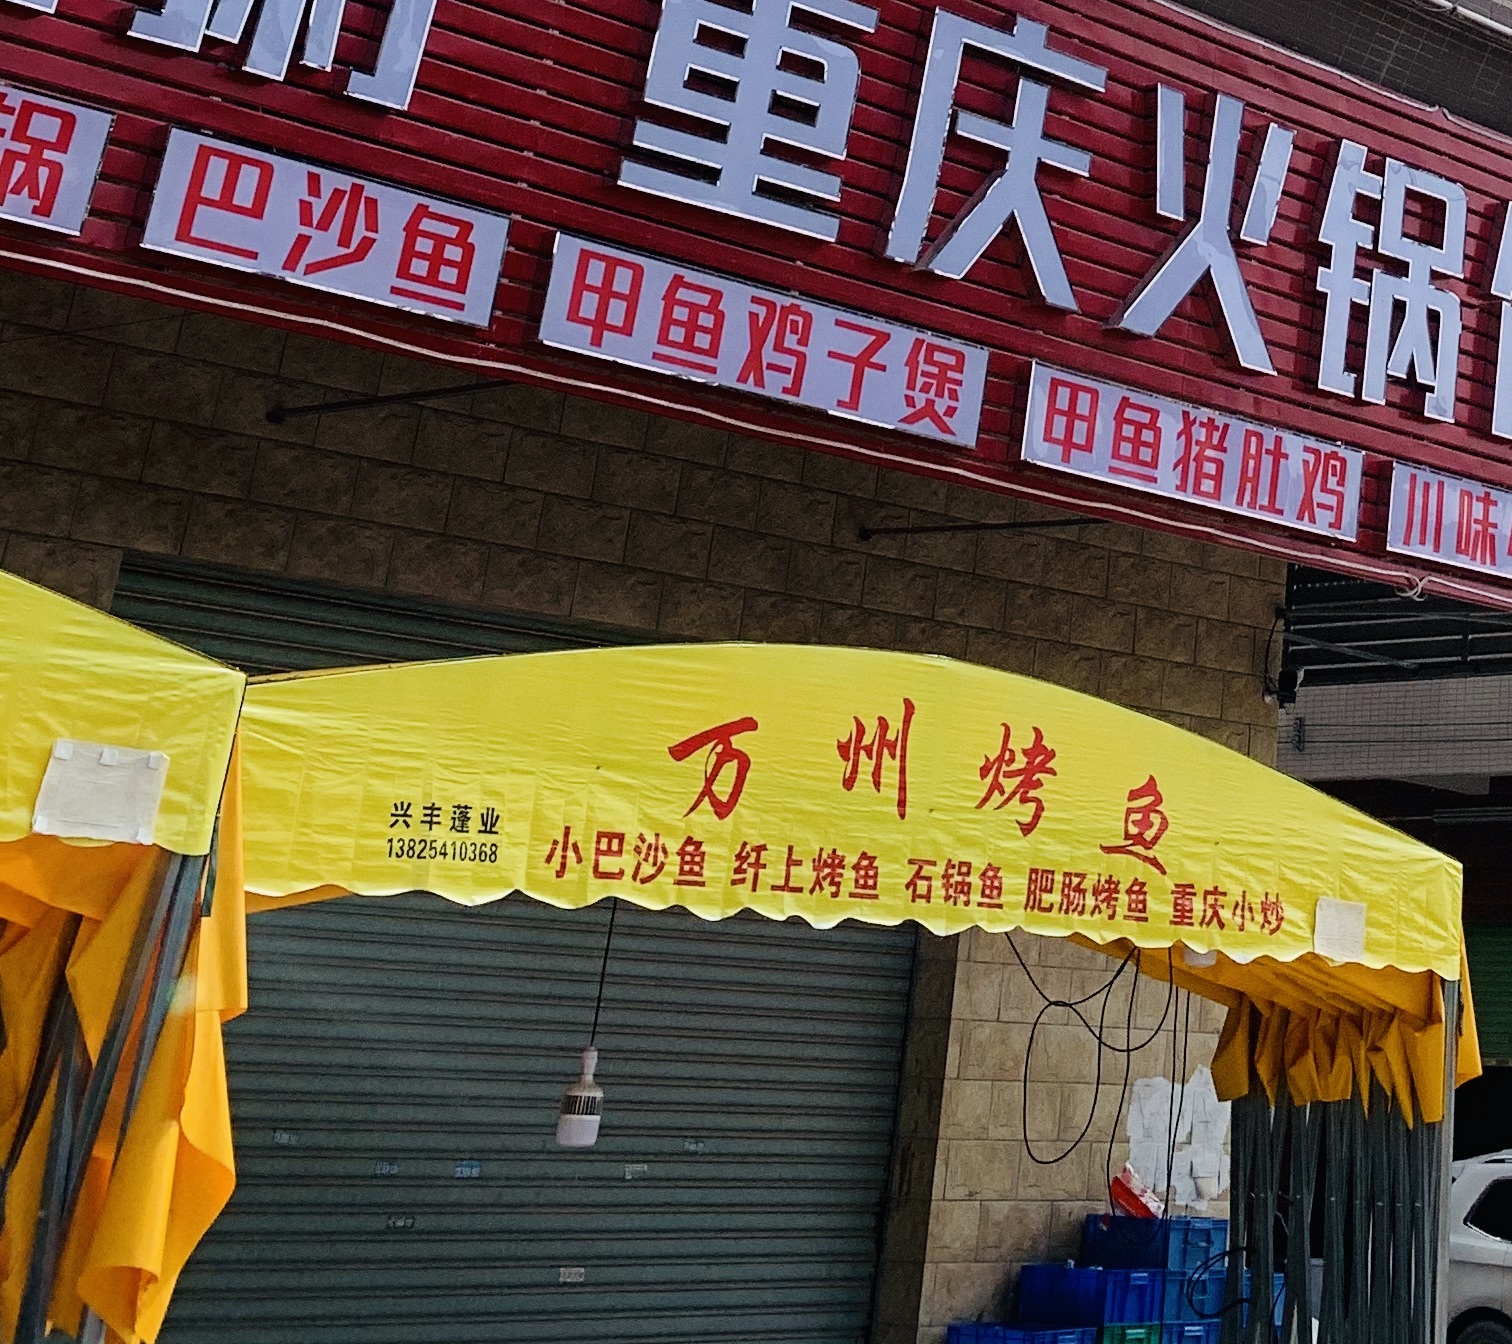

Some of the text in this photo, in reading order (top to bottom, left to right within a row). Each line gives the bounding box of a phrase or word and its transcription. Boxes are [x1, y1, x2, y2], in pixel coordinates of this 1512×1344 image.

[174, 143, 477, 311] 巴沙鱼
[566, 248, 961, 438] 甲鱼鸡子煲
[1043, 376, 1347, 533] 甲鱼猪肚鸡
[386, 837, 498, 864] 13825410368
[667, 697, 1169, 875] 万州烤鱼
[544, 825, 706, 888] 小巴沙鱼
[904, 857, 1004, 910] 石锅鱼
[1023, 867, 1150, 924] 肥肠烤鱼
[1168, 882, 1285, 936] 重庆小炒
